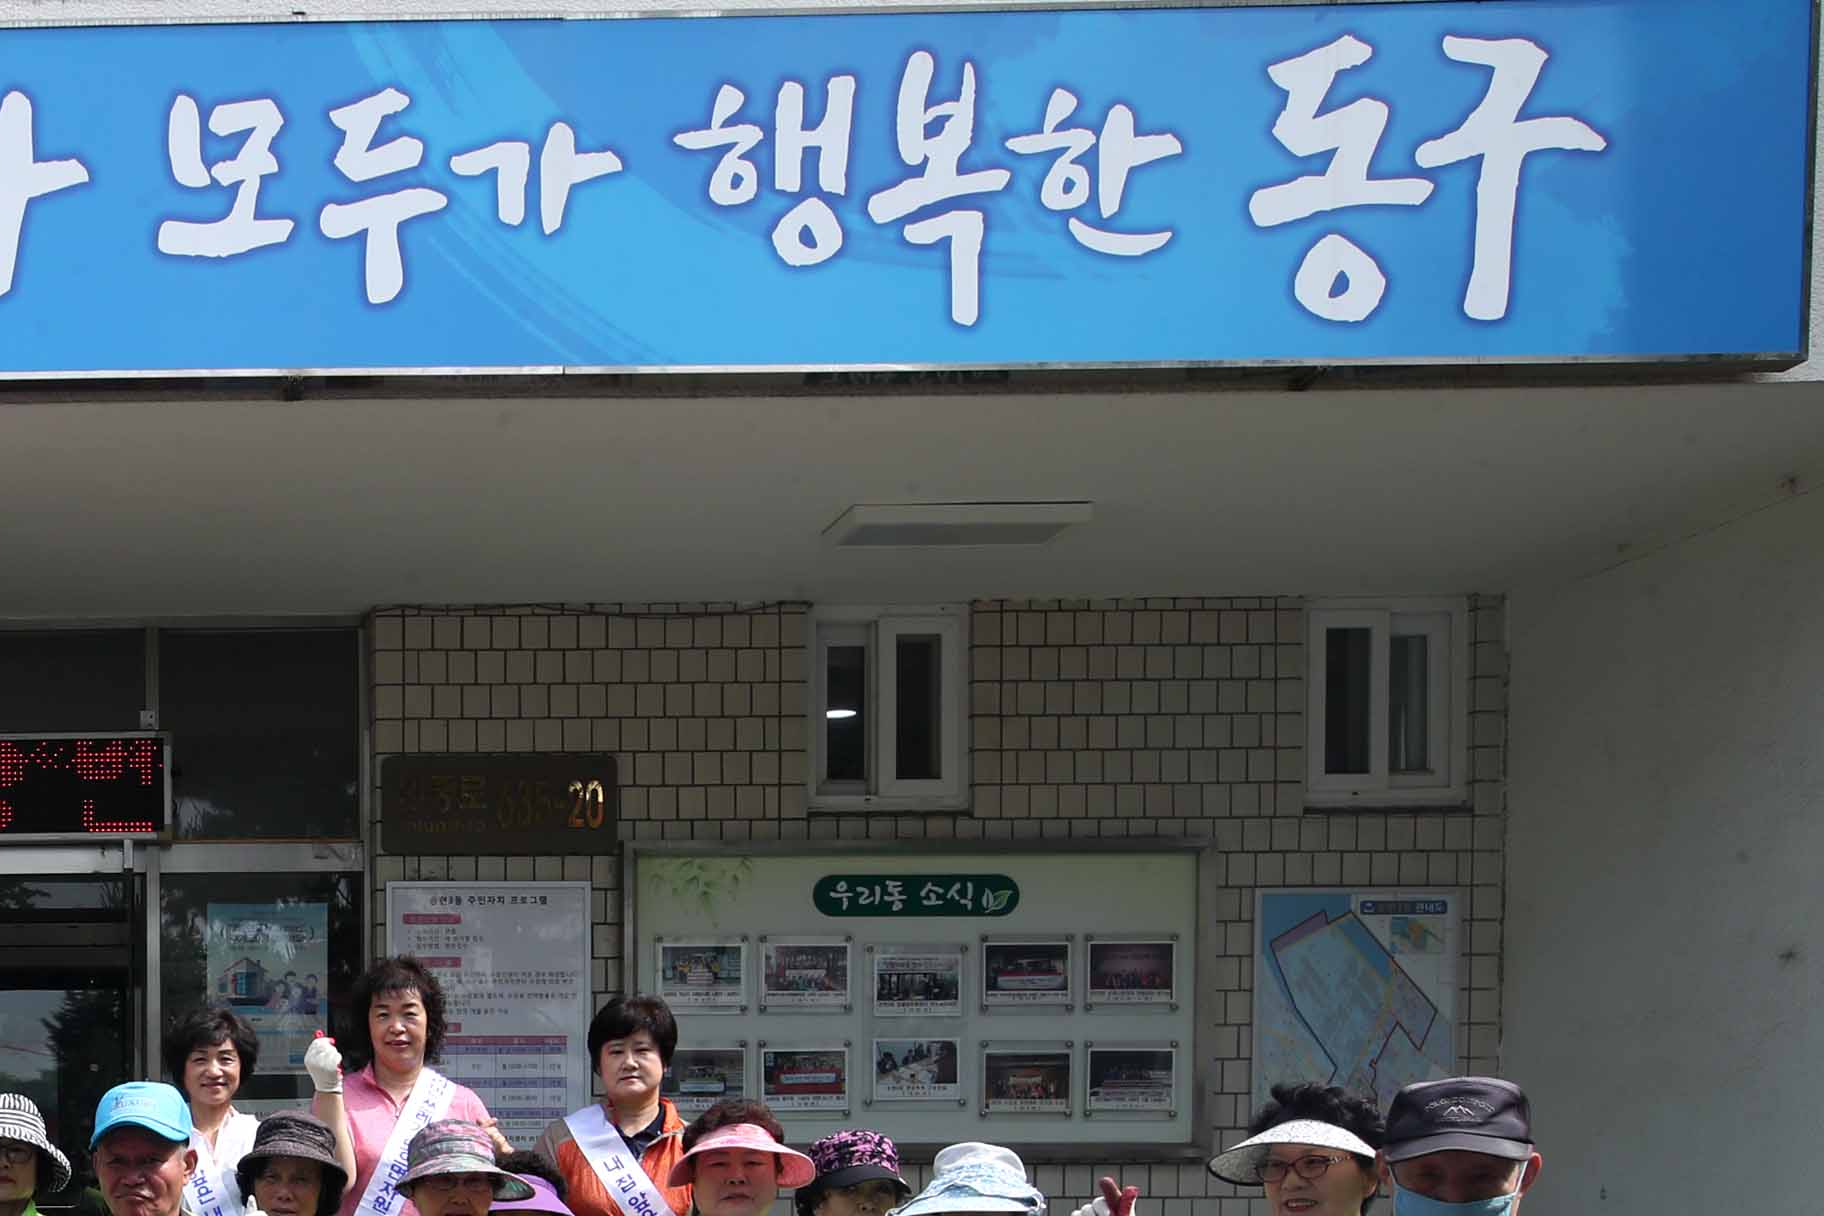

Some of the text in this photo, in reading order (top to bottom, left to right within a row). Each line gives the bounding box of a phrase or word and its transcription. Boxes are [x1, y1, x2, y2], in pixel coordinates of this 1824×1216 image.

[155, 87, 622, 304] 모두가
[674, 51, 1182, 326] 행복한
[1249, 34, 1607, 322] 동구
[567, 780, 606, 830] 20
[829, 880, 975, 914] 우리동 소식
[602, 1154, 625, 1173] 내
[616, 1174, 637, 1194] 집
